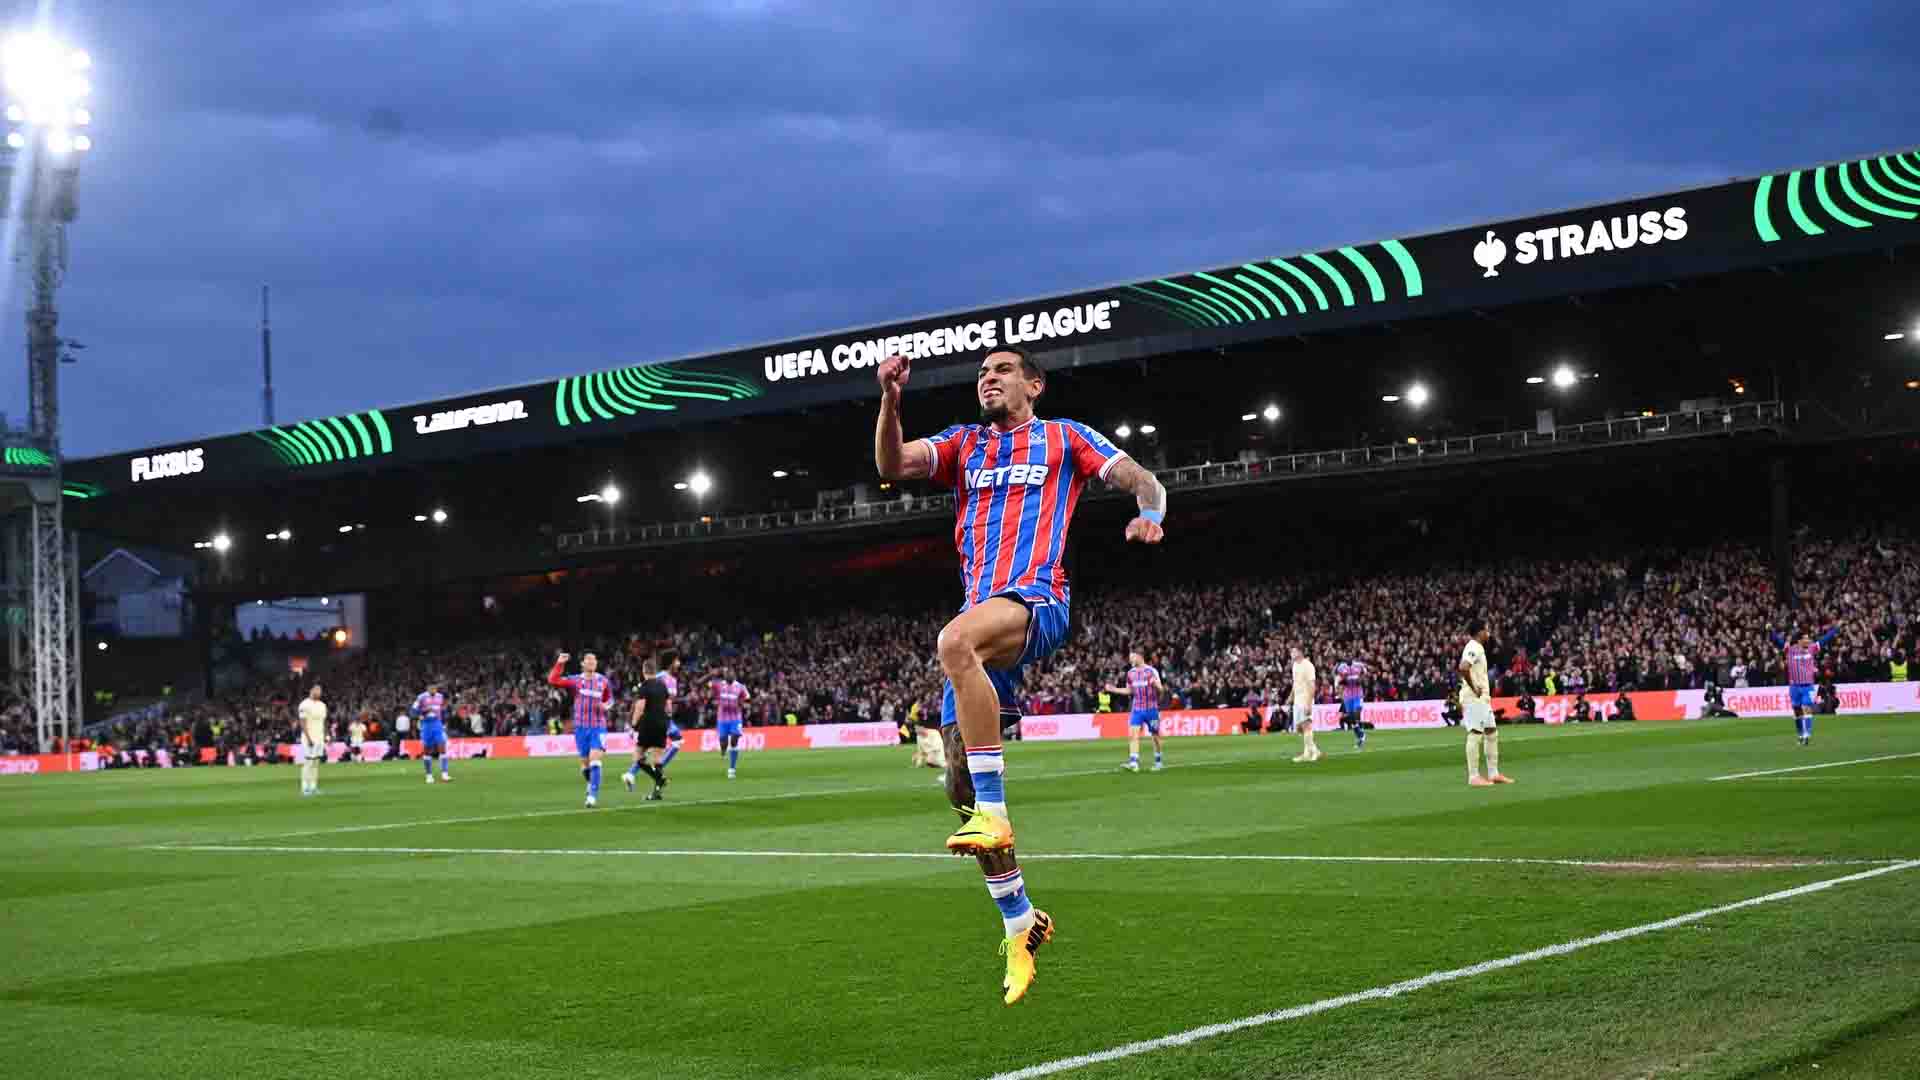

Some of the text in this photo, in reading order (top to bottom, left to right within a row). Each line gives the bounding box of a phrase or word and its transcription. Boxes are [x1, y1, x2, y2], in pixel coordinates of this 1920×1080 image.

[1515, 207, 1688, 264] STRAUSS
[765, 348, 829, 381] UEFA
[831, 320, 998, 371] CONFERENCE
[965, 464, 1049, 489] NET88
[1152, 714, 1220, 735] etano
